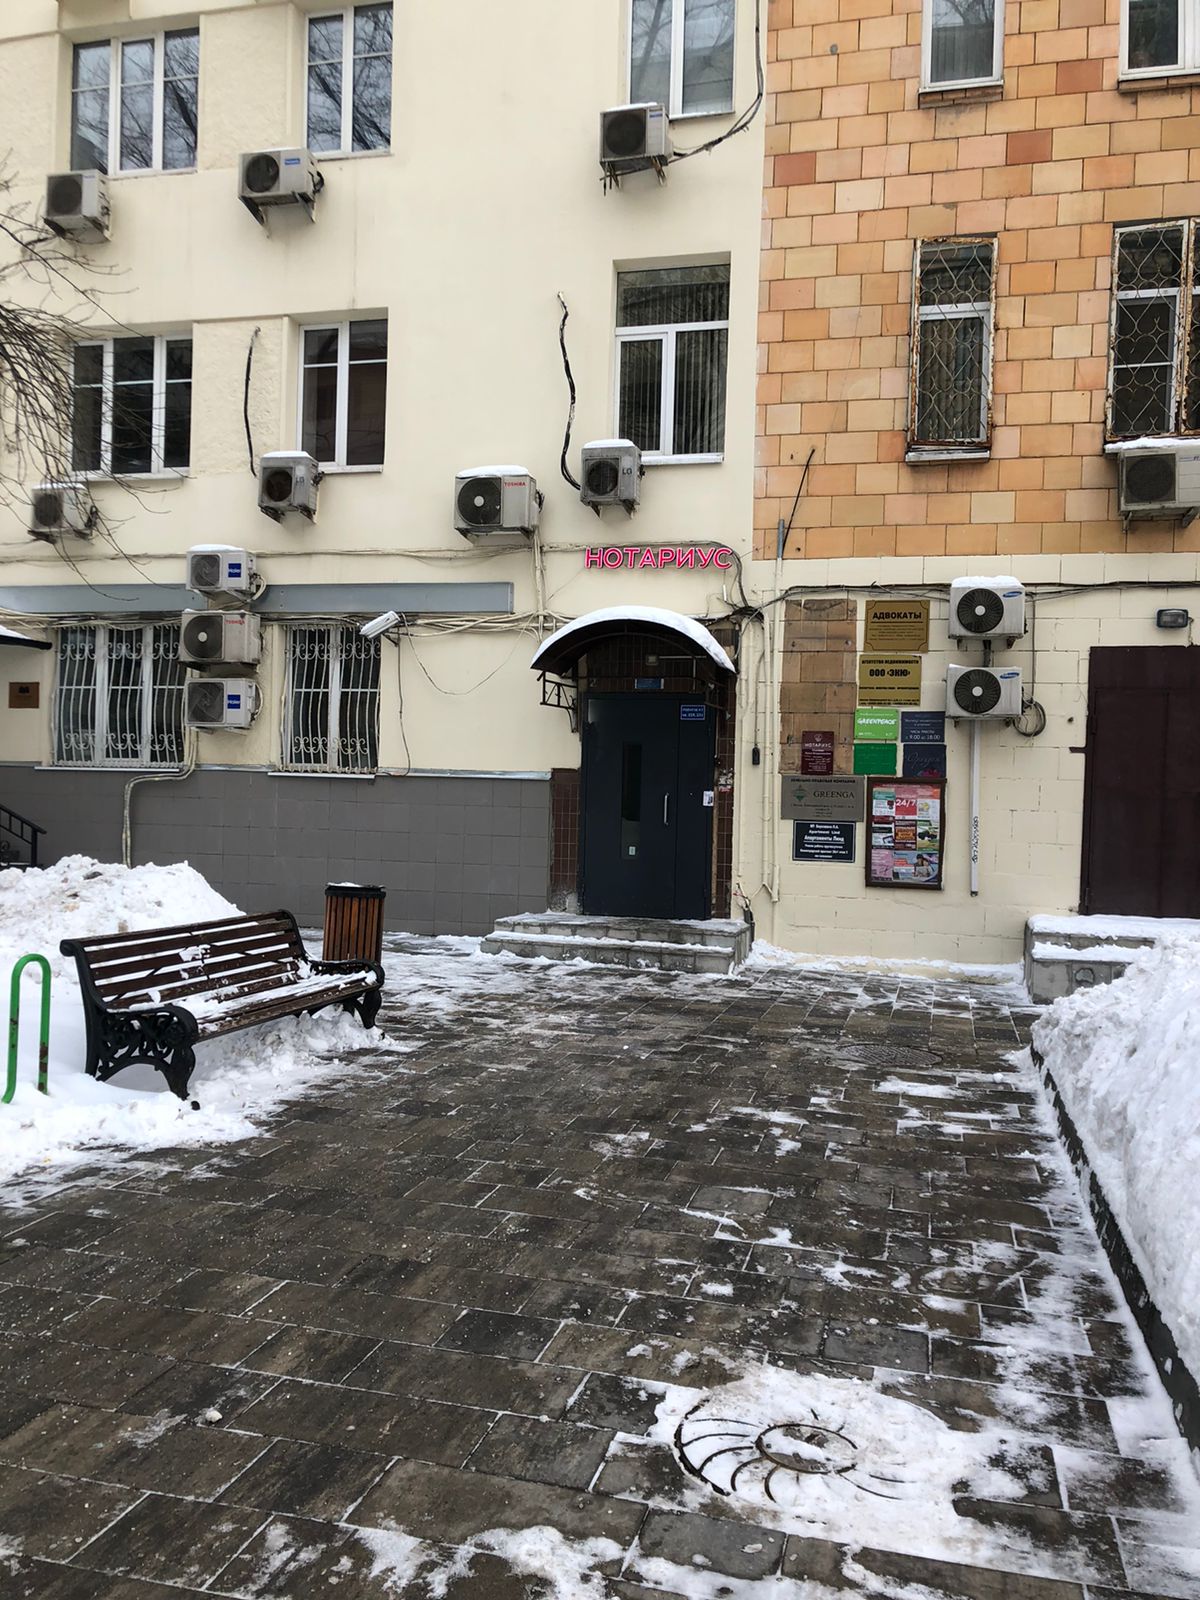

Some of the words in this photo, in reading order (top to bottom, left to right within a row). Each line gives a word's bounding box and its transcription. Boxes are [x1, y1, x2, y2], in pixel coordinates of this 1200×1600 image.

[622, 467, 632, 475] LG
[585, 547, 733, 569] НОТАРИУС
[872, 611, 922, 620] АДВОКАТЫ
[869, 669, 886, 677] ООО
[896, 799, 916, 807] 24/7
